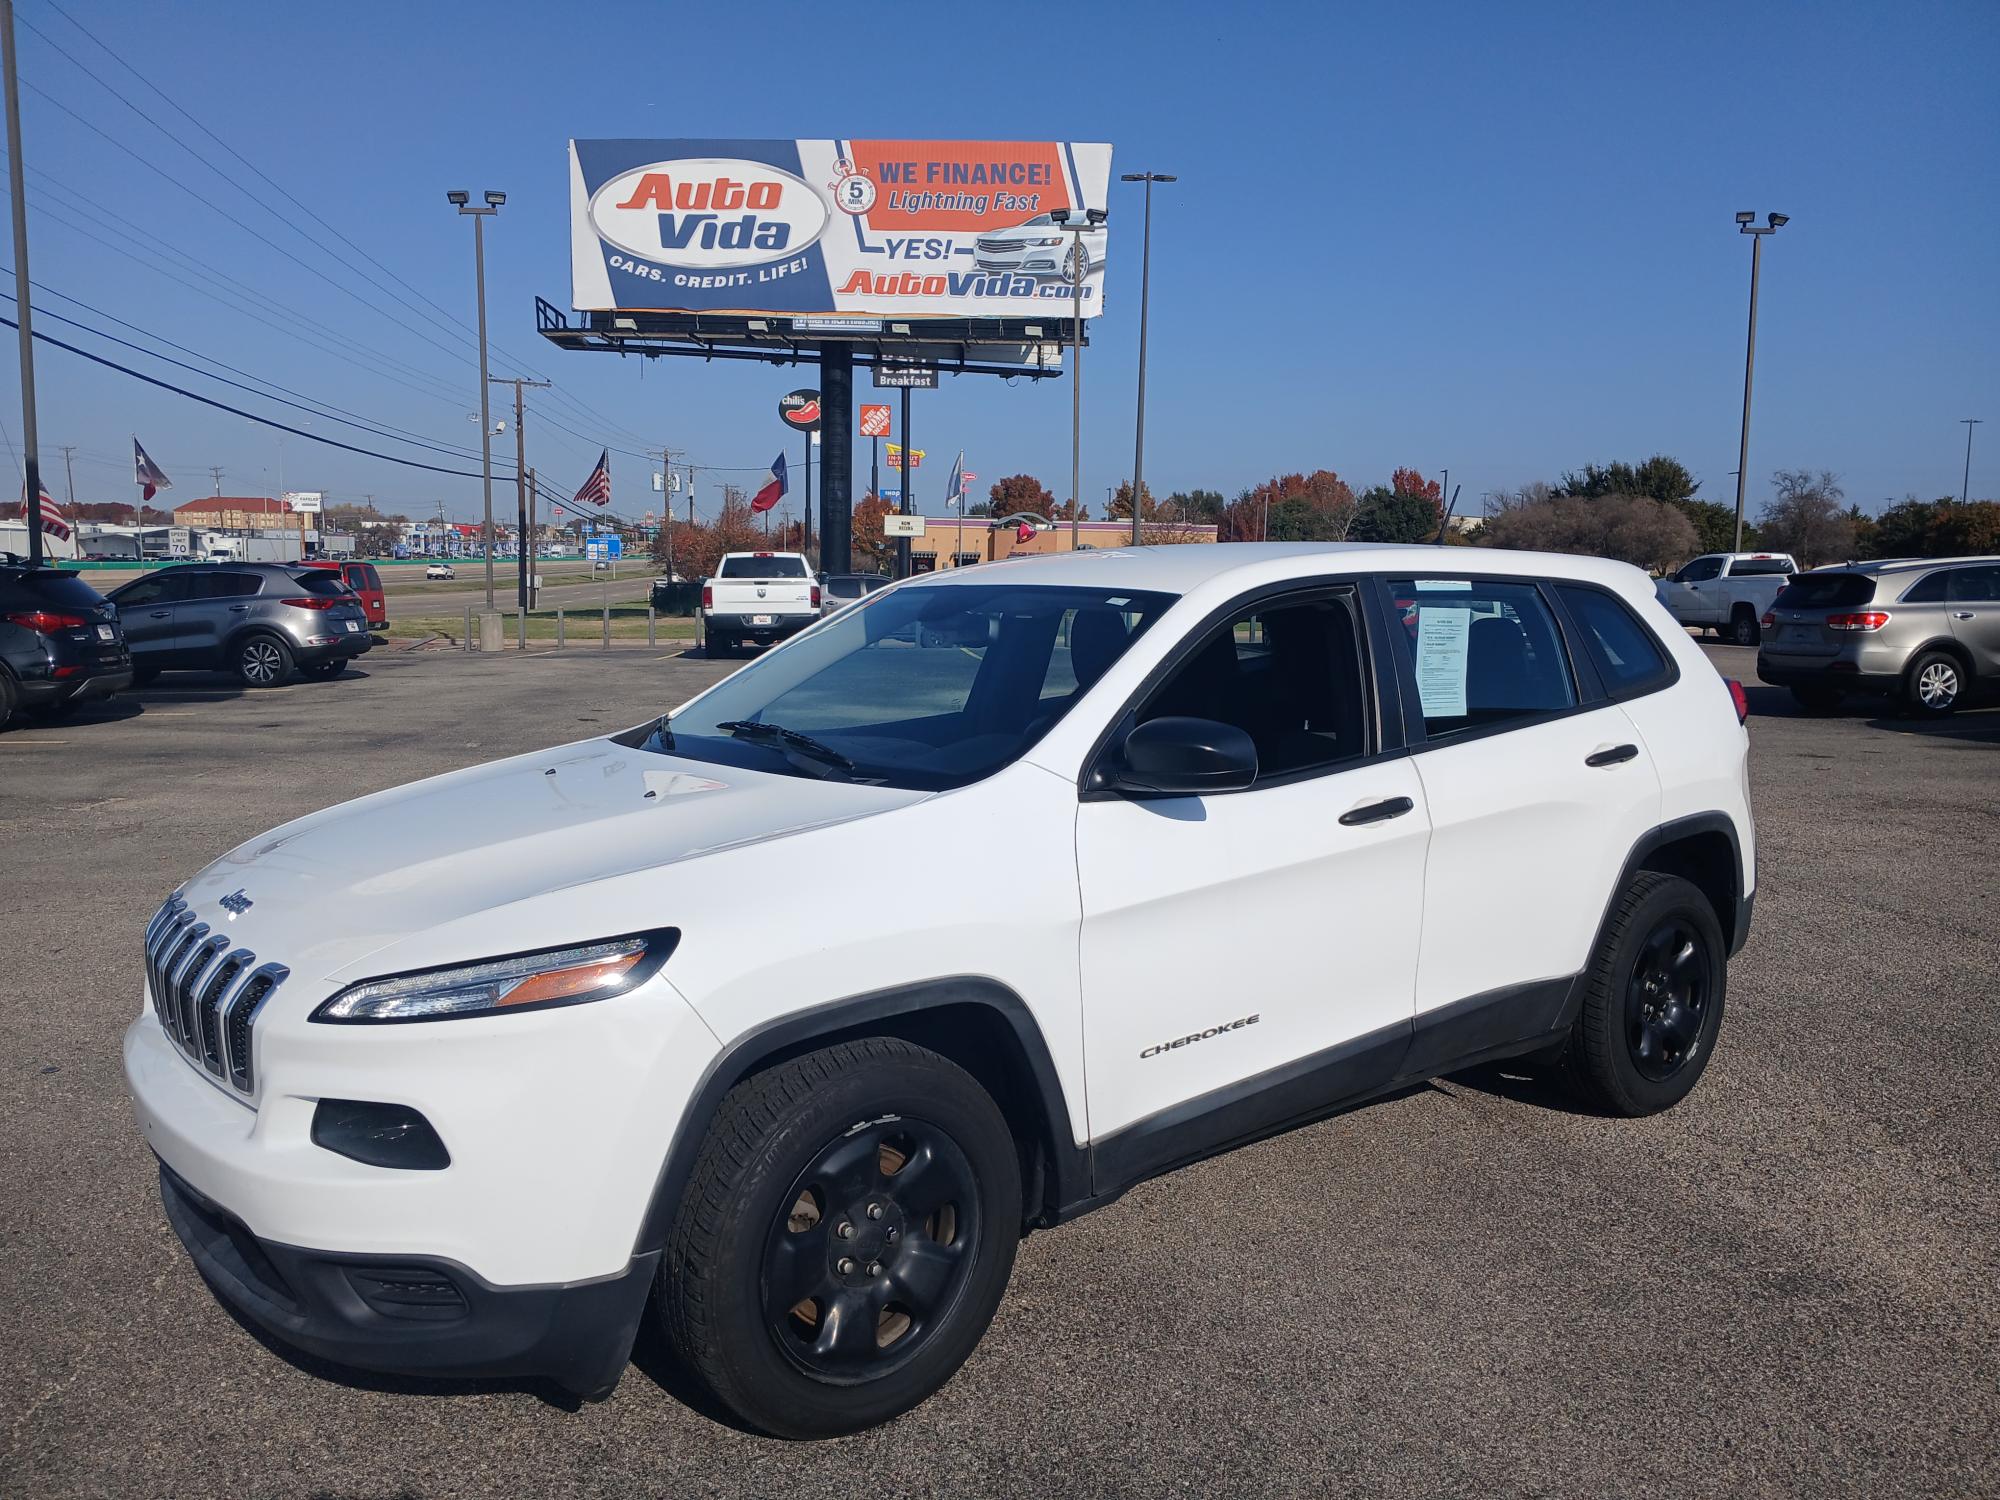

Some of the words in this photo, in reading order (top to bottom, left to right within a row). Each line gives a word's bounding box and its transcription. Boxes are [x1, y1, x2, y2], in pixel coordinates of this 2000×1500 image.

[878, 162, 918, 184] WE
[926, 163, 1051, 186] FINANCE!
[616, 173, 783, 210] Auto
[849, 181, 864, 199] 5
[888, 191, 988, 215] Lightning
[992, 192, 1040, 212] Fast
[657, 213, 791, 250] Vida
[884, 238, 953, 260] YES!
[609, 255, 667, 283] CARS.
[674, 272, 752, 289] CREDIT.
[759, 257, 808, 282] LIFE!
[836, 269, 1093, 300] AutoVida.com
[880, 375, 931, 386] Breakfast
[860, 405, 890, 435] HOME
[864, 408, 876, 420] THE
[872, 417, 890, 435] DEPOT
[172, 544, 187, 553] 70
[1139, 1013, 1260, 1059] CHEROKEE
